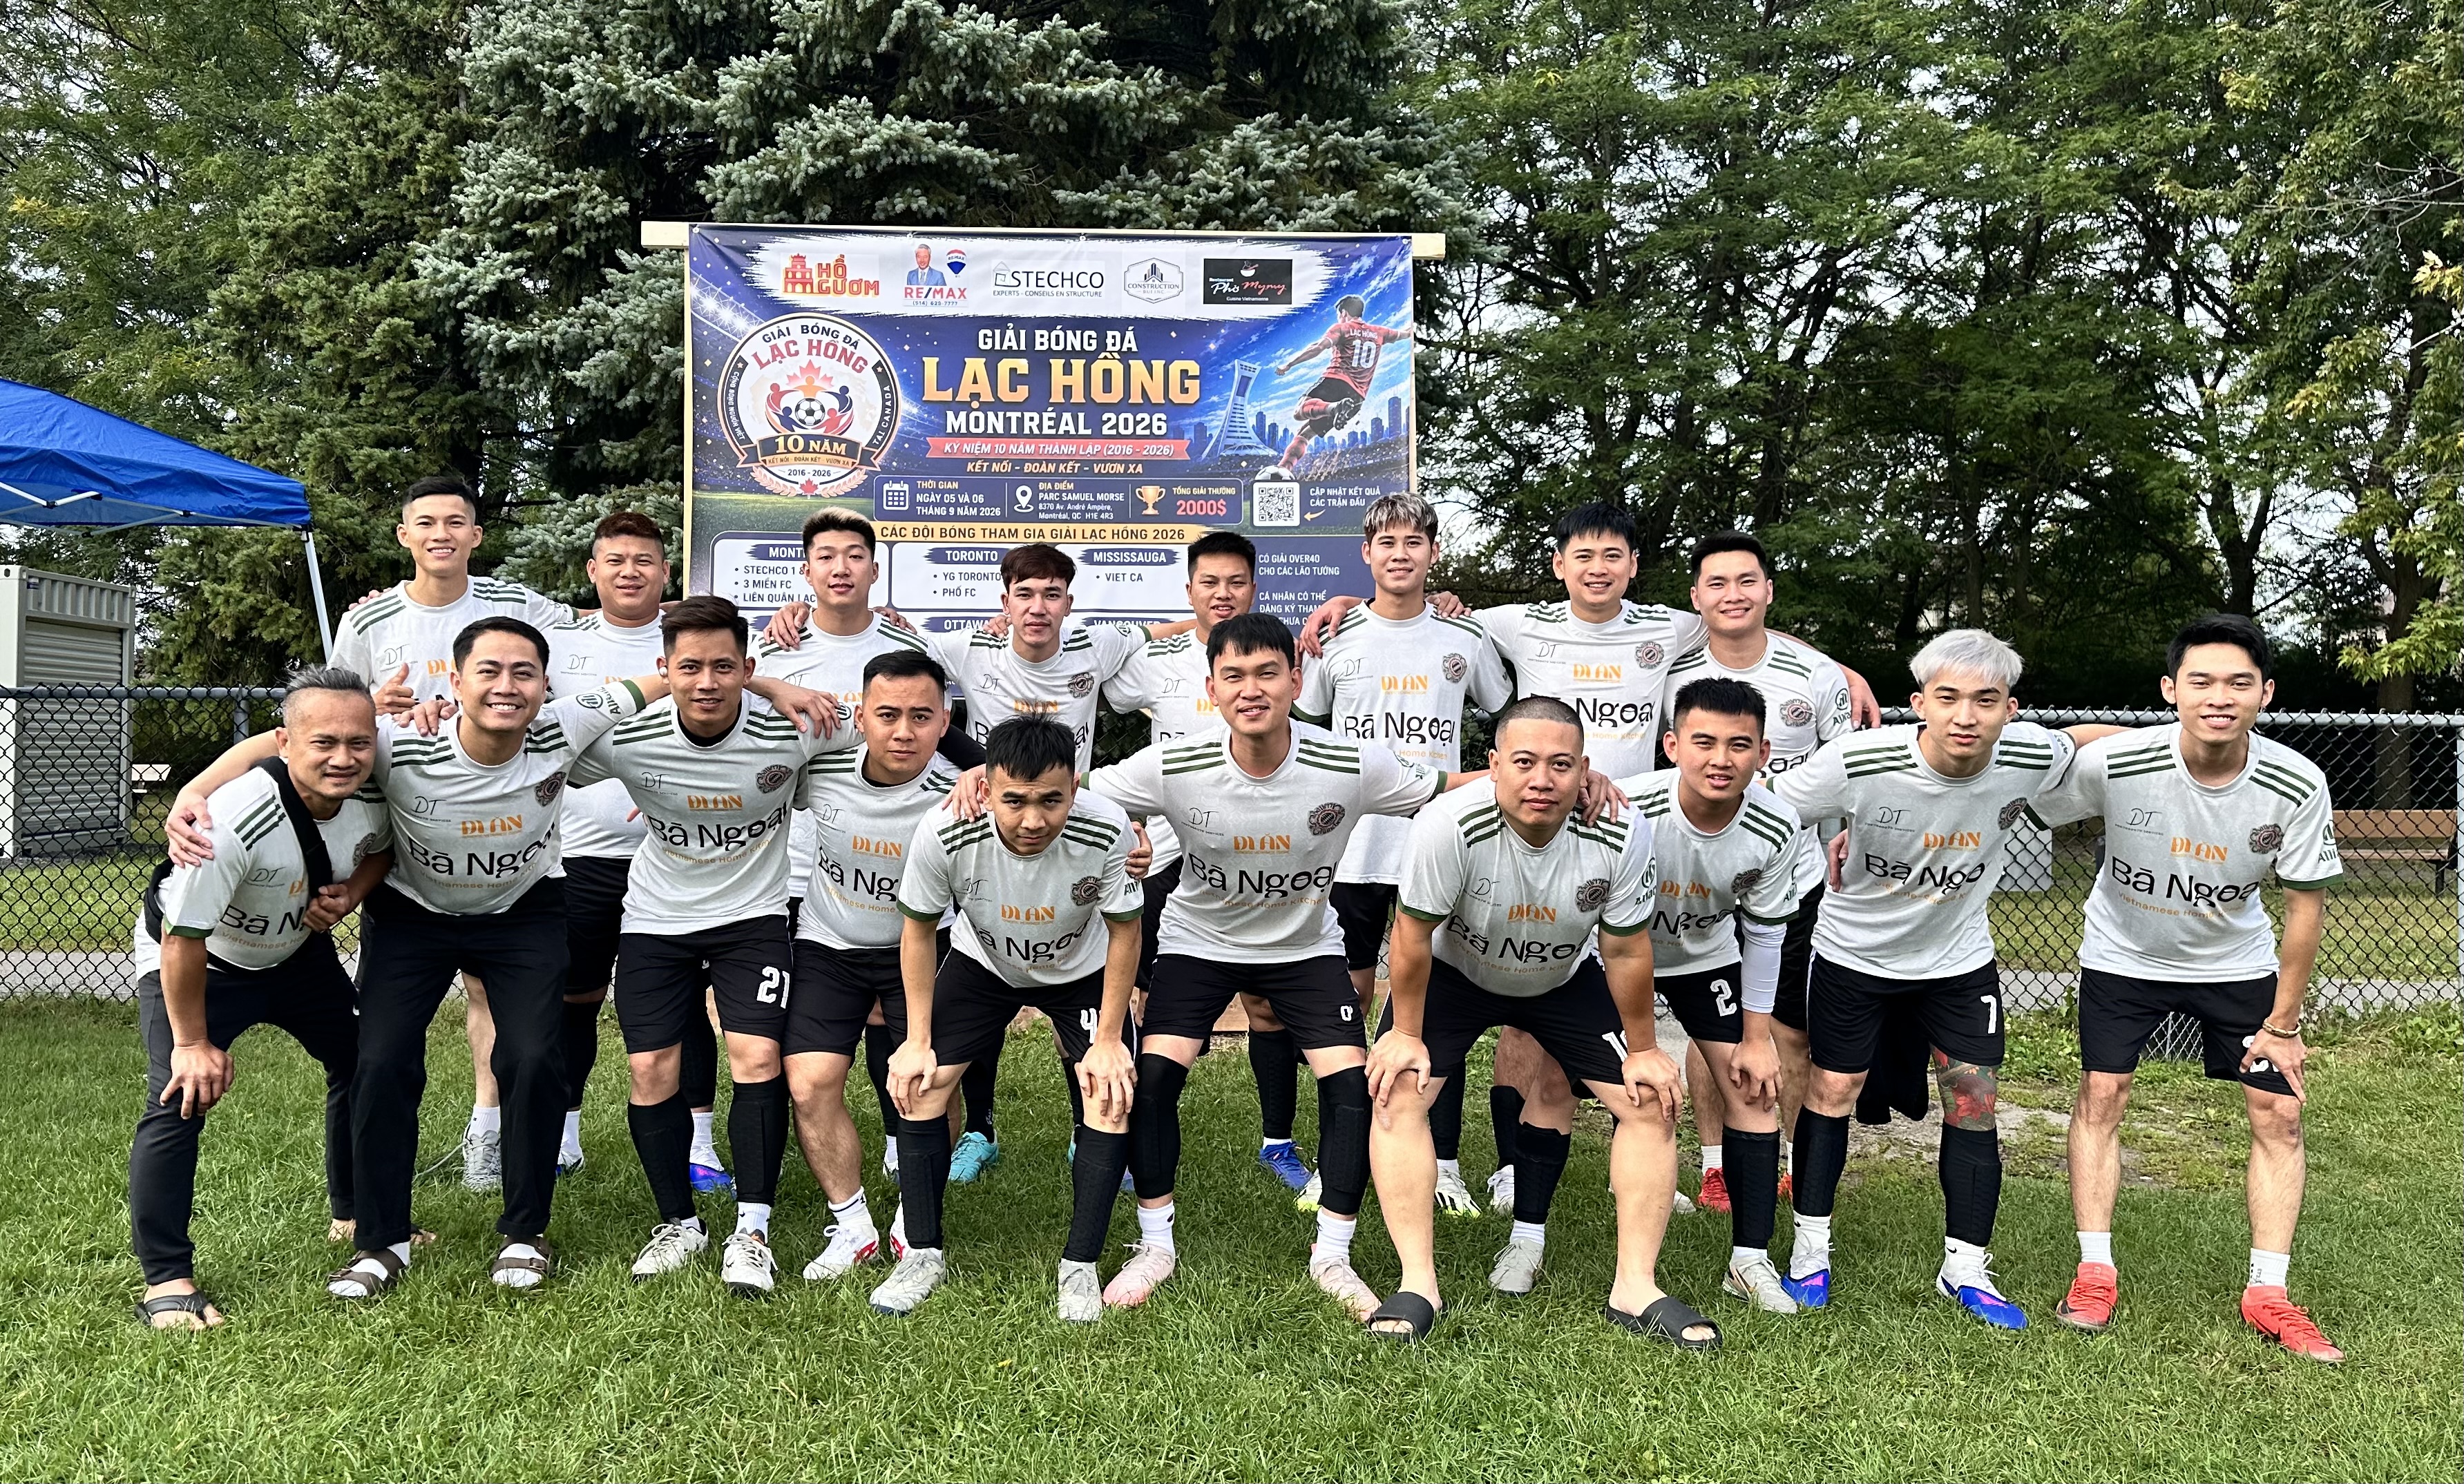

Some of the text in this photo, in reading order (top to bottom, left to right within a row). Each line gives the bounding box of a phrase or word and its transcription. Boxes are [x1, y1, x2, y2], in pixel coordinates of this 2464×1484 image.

[818, 253, 847, 278] HỒ
[1011, 270, 1105, 289] STECHCO
[818, 278, 880, 296] GƯƠM
[904, 287, 967, 299] RE/MAX
[762, 322, 861, 351] GIẢI BÓNG ĐÁ
[978, 322, 1138, 352] GIẢI BÓNG ĐÁ
[751, 338, 868, 374] LẠC HỒNG
[1351, 339, 1377, 369] 10
[922, 351, 1201, 409] LẠC HỒNG
[881, 385, 892, 428] CANADA
[946, 406, 1167, 436] MONTRÉAL 2026
[774, 434, 847, 455] 10 NĂM
[962, 441, 991, 457] NIỆM
[993, 443, 1006, 454] 10
[1009, 443, 1036, 455] NĂM
[1038, 442, 1076, 456] THÀNH
[1078, 442, 1101, 458] LẬP
[1103, 444, 1134, 457] (2016
[1142, 445, 1175, 458] 2026)
[812, 469, 832, 477] 2026
[966, 459, 1143, 474] KẾT NỐI ĐOÀN KẾT VƯƠN XA
[917, 479, 959, 490] THỜI GIAN
[1054, 479, 1074, 490] ĐIỂM
[1192, 485, 1207, 495] GIẢI
[1348, 485, 1363, 497] KẾT
[916, 491, 984, 504] NGÀY 05 VÀ 06
[1038, 492, 1125, 502] PARC SAMUEL MORSE
[1310, 496, 1325, 507] CÁC
[1349, 496, 1366, 507] ĐẤU
[916, 504, 1001, 517] THÁNG 9 NĂM 2026
[1055, 503, 1066, 511] Av.
[1067, 503, 1086, 511] André
[1087, 503, 1113, 512] Ampère,
[1176, 498, 1228, 517] 2000$
[1038, 510, 1114, 521] Montréal, QC H1E 4R3
[880, 524, 907, 538] CÁC
[911, 525, 935, 541] ĐỘI
[939, 525, 976, 539] BÓNG
[980, 528, 1019, 539] THAM
[1023, 528, 1046, 539] GIA
[1049, 523, 1077, 540] GIẢI
[1081, 528, 1107, 543] LẠC
[1153, 529, 1185, 540] 2026
[768, 547, 806, 558] MONT
[945, 550, 999, 562] TORONTO
[1093, 551, 1167, 563] MISSISSAUGA
[1259, 552, 1320, 563] CÓ GIẢI OVER40
[743, 565, 796, 575] STECHCO 1
[1259, 563, 1340, 576] CHO CÁC LÃO TƯỚNG
[942, 572, 1002, 581] YG TORONTO
[1105, 572, 1144, 582] VIET CA
[743, 579, 749, 588] 3
[780, 580, 792, 589] FC
[743, 591, 794, 604] LIÊN QUÂN
[964, 588, 977, 597] FC
[1259, 589, 1326, 601] CÁ NHÂN CÓ THỂ
[1259, 602, 1283, 613] ĐĂNG
[1399, 749, 1426, 758] Home
[1187, 807, 1220, 828] DT
[1875, 806, 1911, 825] DT
[2126, 807, 2163, 827] DT
[868, 903, 896, 914] Home
[2118, 891, 2180, 916] Vietnamese
[221, 930, 287, 950] Vietnamese
[756, 965, 790, 1010] 21
[1710, 978, 1738, 1017] 2
[1980, 994, 1998, 1034] 7
[1080, 1008, 1102, 1044] 4
